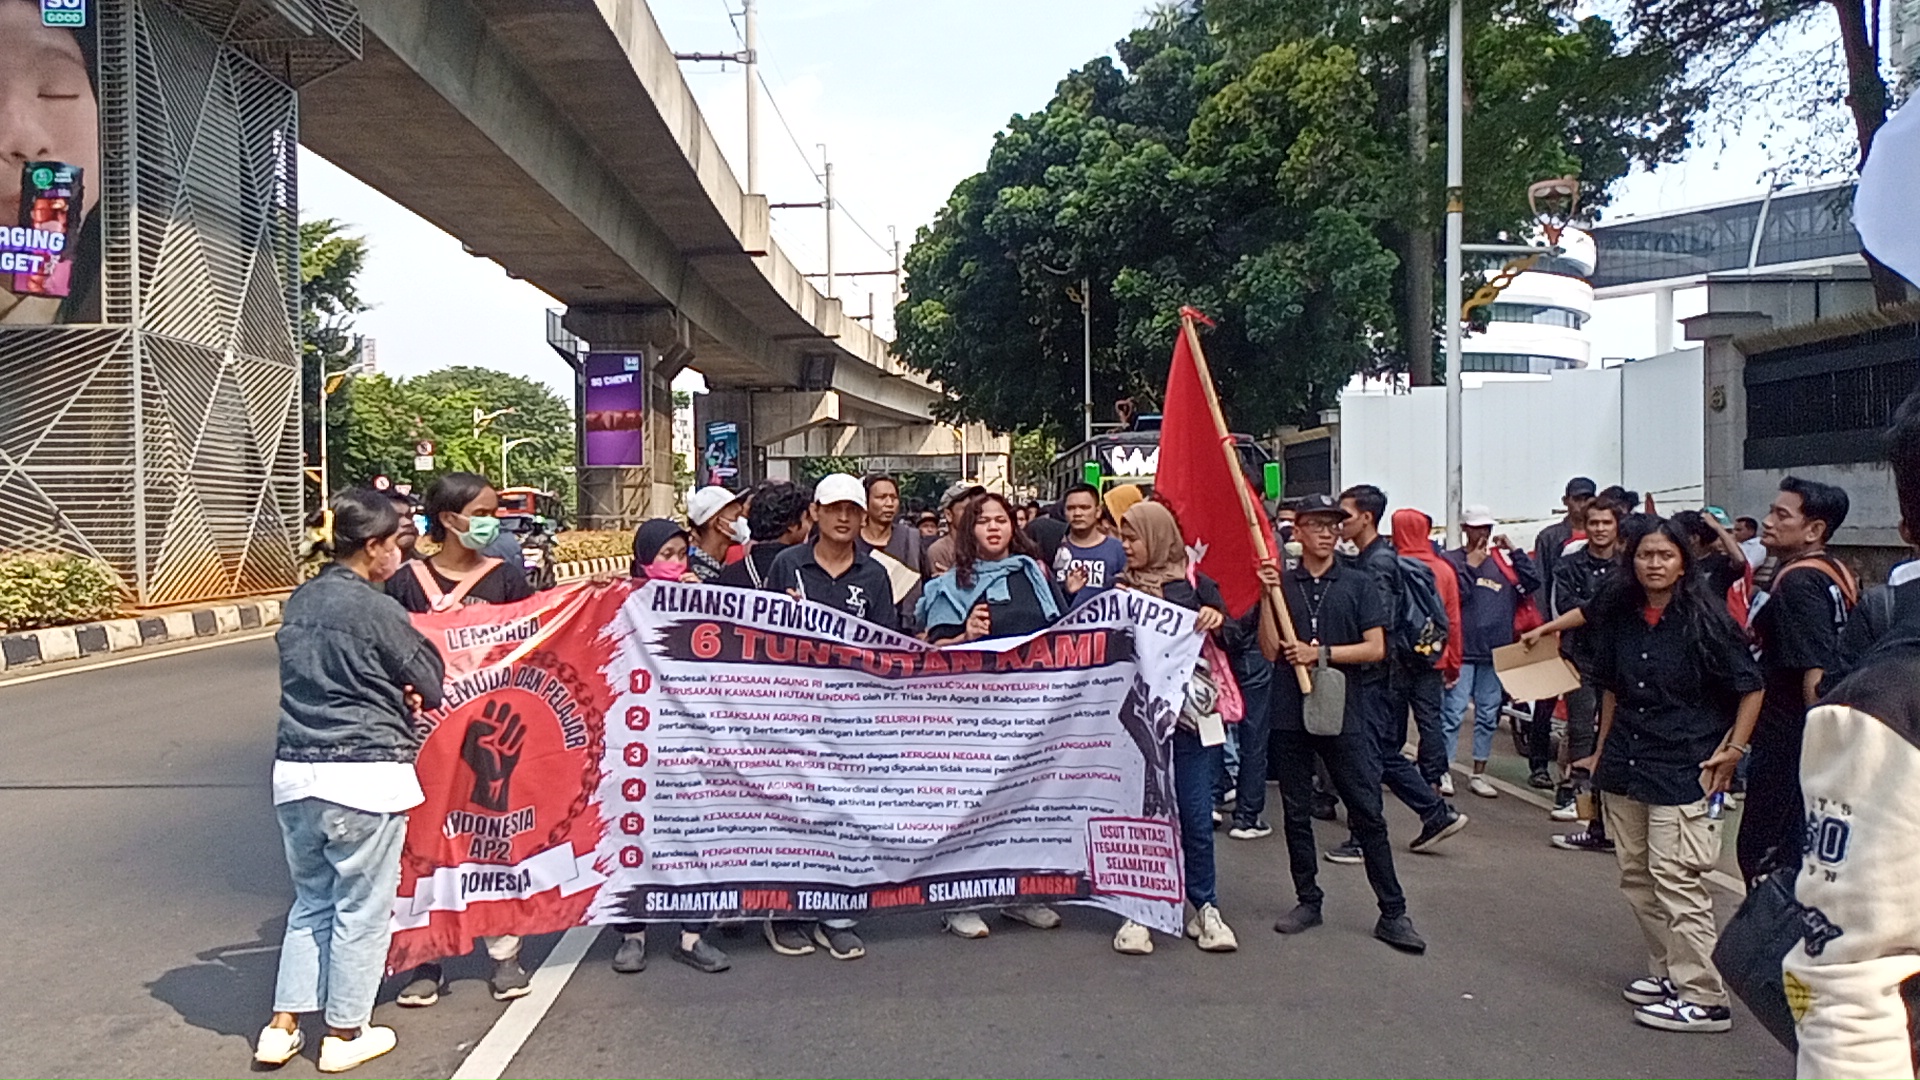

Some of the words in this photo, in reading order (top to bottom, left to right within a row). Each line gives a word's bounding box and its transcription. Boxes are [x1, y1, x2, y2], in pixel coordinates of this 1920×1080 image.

[47, 13, 81, 22] GOOD
[0, 253, 44, 273] GET
[651, 585, 746, 619] ALIANSI
[752, 596, 847, 640] PEMUDA
[691, 623, 722, 659] 6
[734, 627, 983, 676] TUNTUTAN
[996, 631, 1106, 668] KAMI
[660, 674, 707, 682] Mendesak
[710, 674, 770, 685] KEJAKSAAN
[773, 677, 808, 687] AGUNG
[812, 679, 822, 688] RI
[825, 681, 853, 690] segera
[660, 686, 721, 697] PERUSAKAN
[725, 689, 776, 698] KAWASAN
[779, 690, 814, 700] HUTAN
[816, 692, 861, 701] LINDUNG
[902, 692, 924, 701] Trias
[949, 694, 979, 704] Agung
[439, 666, 511, 717] EMUDA
[514, 665, 547, 693] DAN
[541, 678, 587, 749] PELAJAR
[660, 708, 705, 719] Mendesak
[710, 710, 770, 721] KEJAKSAAN
[773, 713, 808, 722] AGUNG
[812, 715, 822, 723] RI
[874, 715, 920, 723] SELURUH
[956, 717, 978, 726] yang
[729, 725, 751, 735] yang
[818, 727, 853, 738] dengan
[901, 729, 946, 738] peraturan
[658, 745, 705, 754] Mendesak
[708, 746, 767, 755] KEJAKSAAN
[900, 751, 950, 760] KERUGIAN
[953, 752, 991, 761] NEGARA
[785, 760, 825, 769] KHUSUS
[868, 765, 890, 774] yang
[654, 792, 672, 801] dan
[675, 789, 737, 801] INVESTIGASI
[656, 779, 701, 788] Mendesak
[705, 779, 764, 791] KEJAKSAAN
[881, 786, 914, 796] dengan
[653, 814, 700, 823] Mendesak
[703, 811, 762, 822] KEJAKSAAN
[763, 812, 798, 824] AGUNG
[717, 825, 767, 834] lingkungan
[1099, 825, 1125, 840] USUT
[470, 838, 511, 861] AP2
[652, 850, 699, 859] Mendesak
[702, 847, 772, 858] PENGHENTIAN
[775, 847, 835, 860] SEMENTARA
[652, 861, 708, 871] KEPASTIAN
[645, 890, 738, 911] SELAMATKAN
[797, 890, 868, 911] TEGAKKAN
[929, 877, 1016, 902] SELAMATKAN
